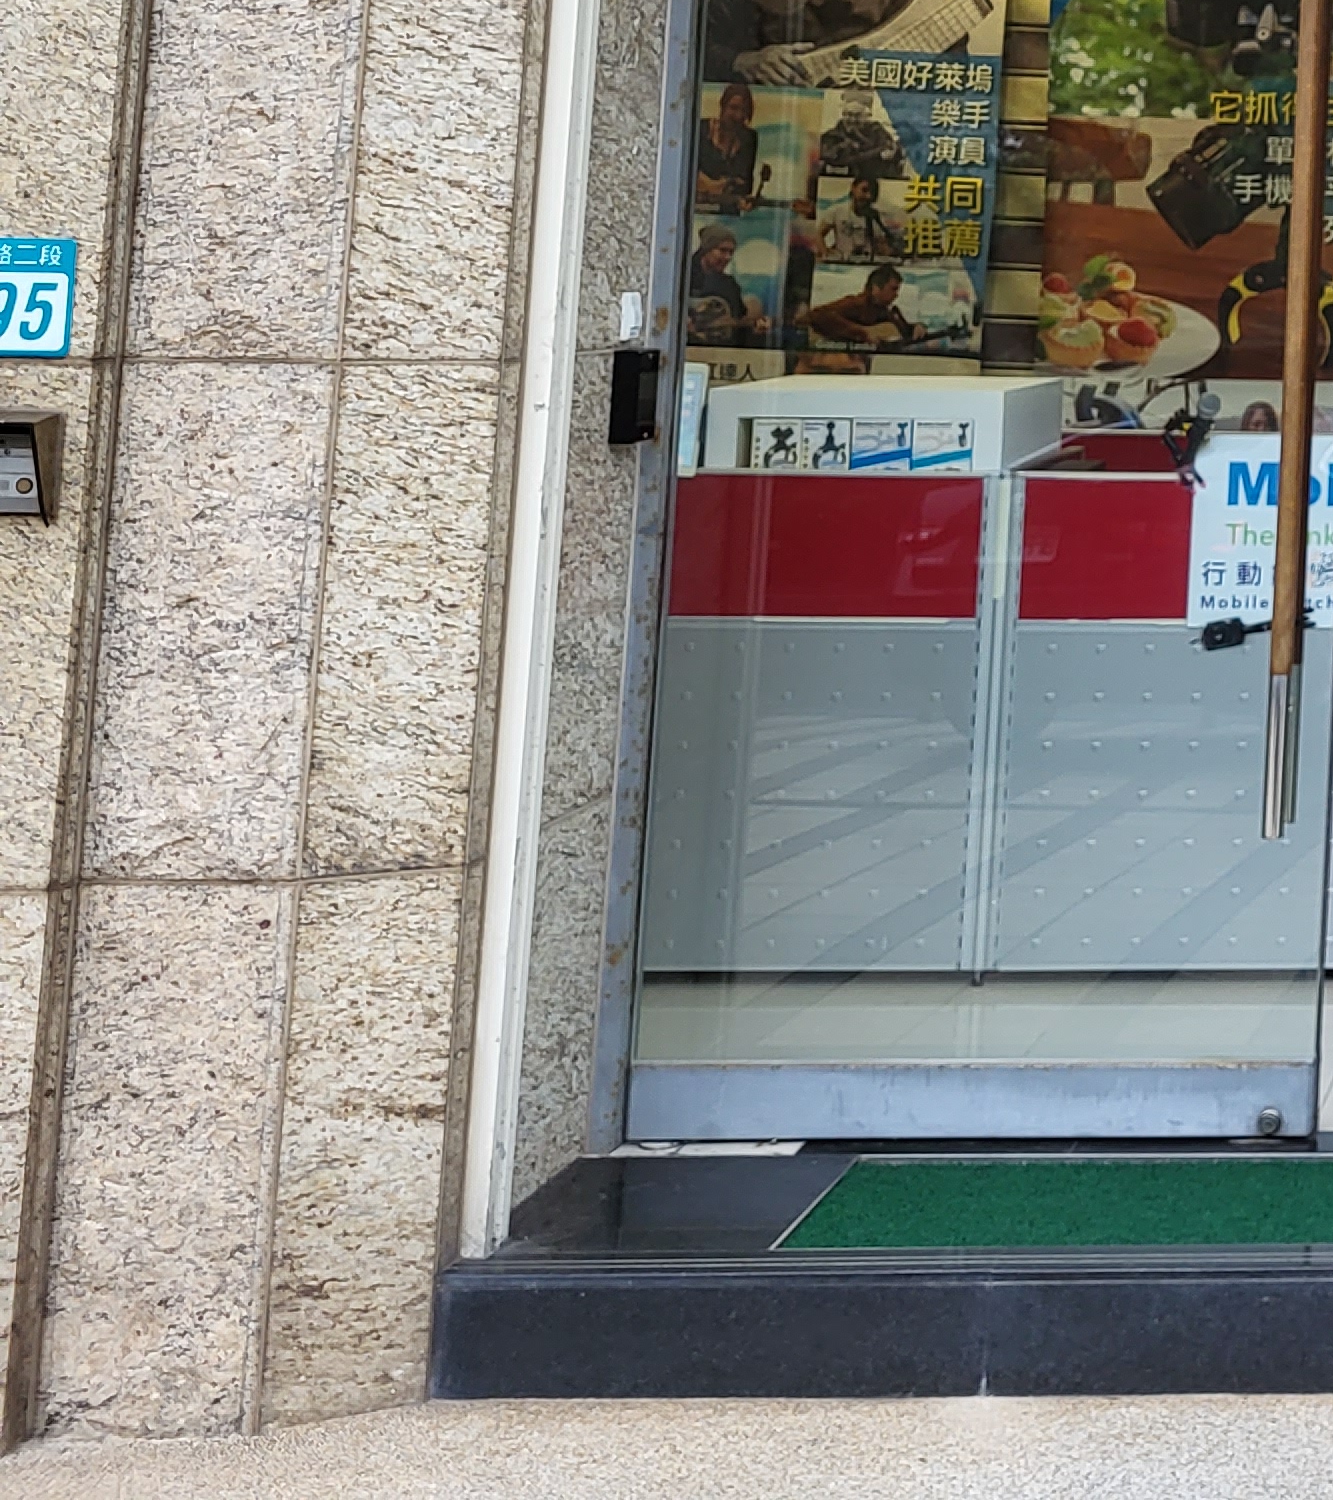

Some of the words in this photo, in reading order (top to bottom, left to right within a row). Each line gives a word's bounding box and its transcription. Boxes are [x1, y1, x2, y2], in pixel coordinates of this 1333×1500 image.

[840, 57, 994, 94] 美國好萊塢
[930, 98, 991, 129] 樂手
[927, 135, 987, 166] 演員
[904, 174, 984, 215] 共同
[1225, 523, 1274, 546] The
